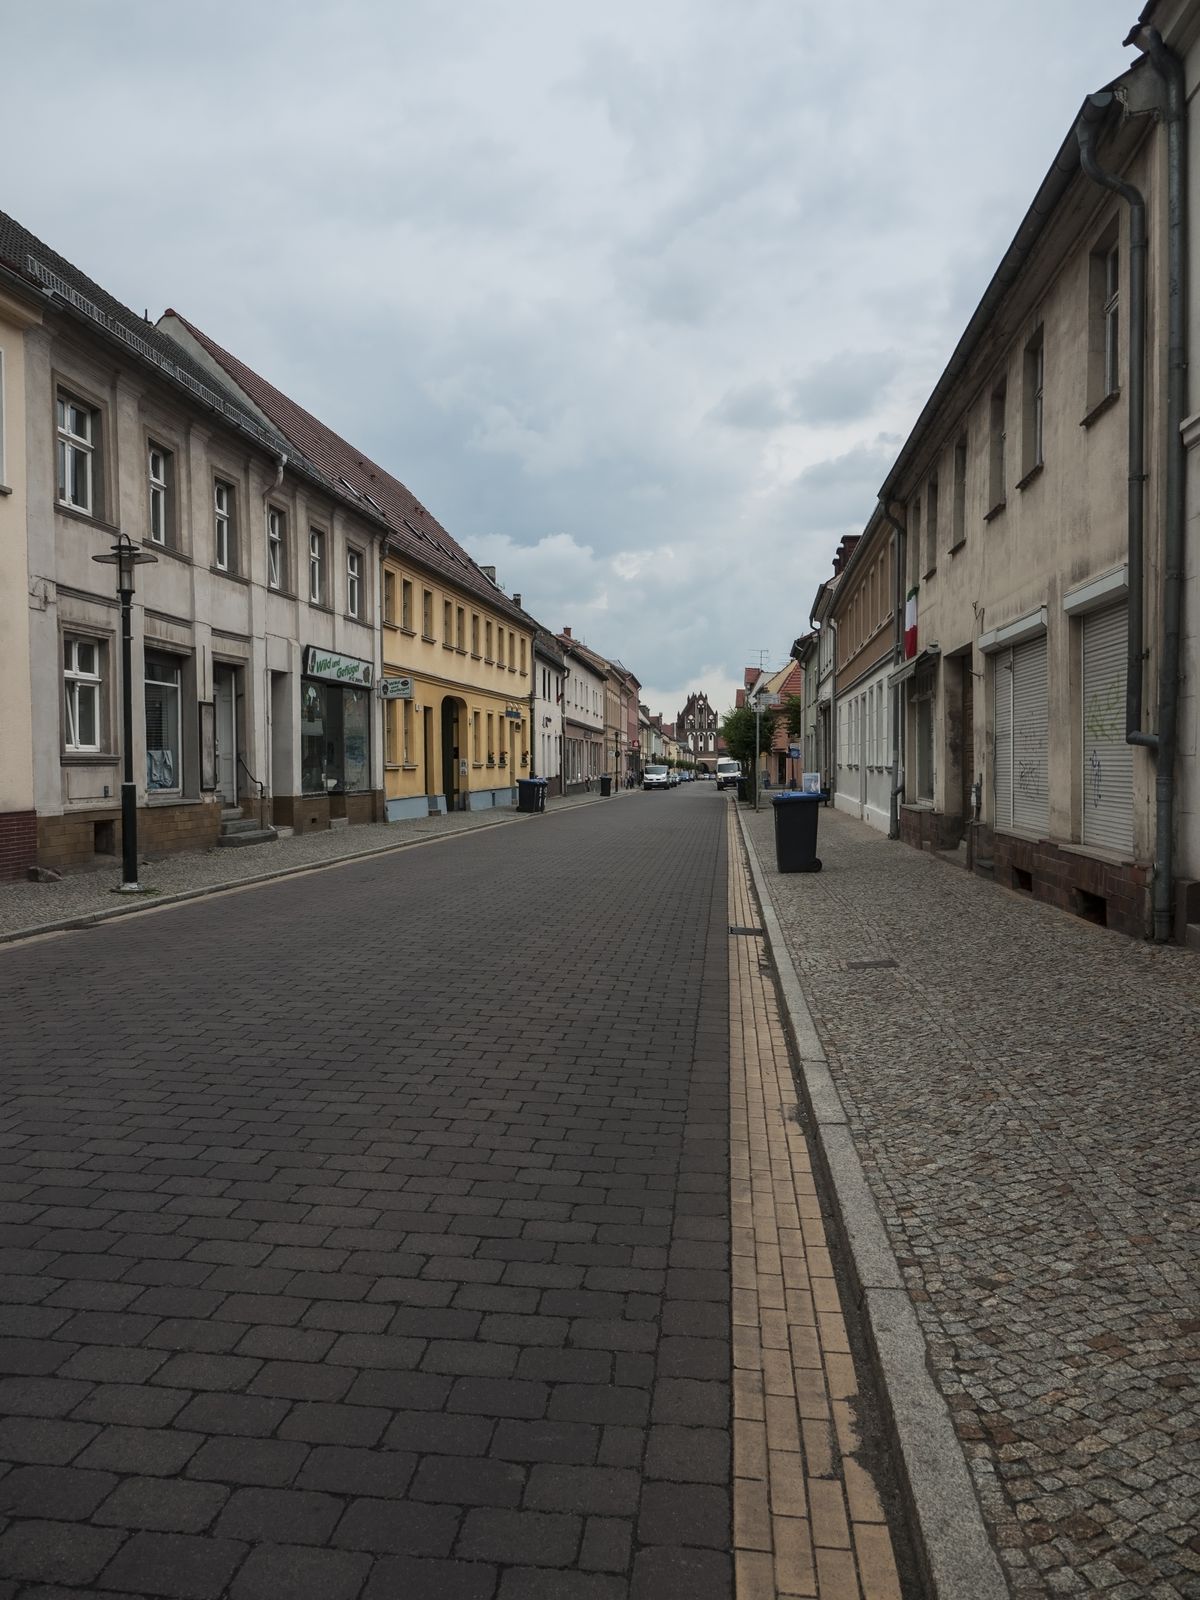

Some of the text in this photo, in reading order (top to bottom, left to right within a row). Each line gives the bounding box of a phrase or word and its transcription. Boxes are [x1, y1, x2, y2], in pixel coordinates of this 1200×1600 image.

[316, 657, 341, 673] Wild und
[337, 662, 360, 678] Geflügel
